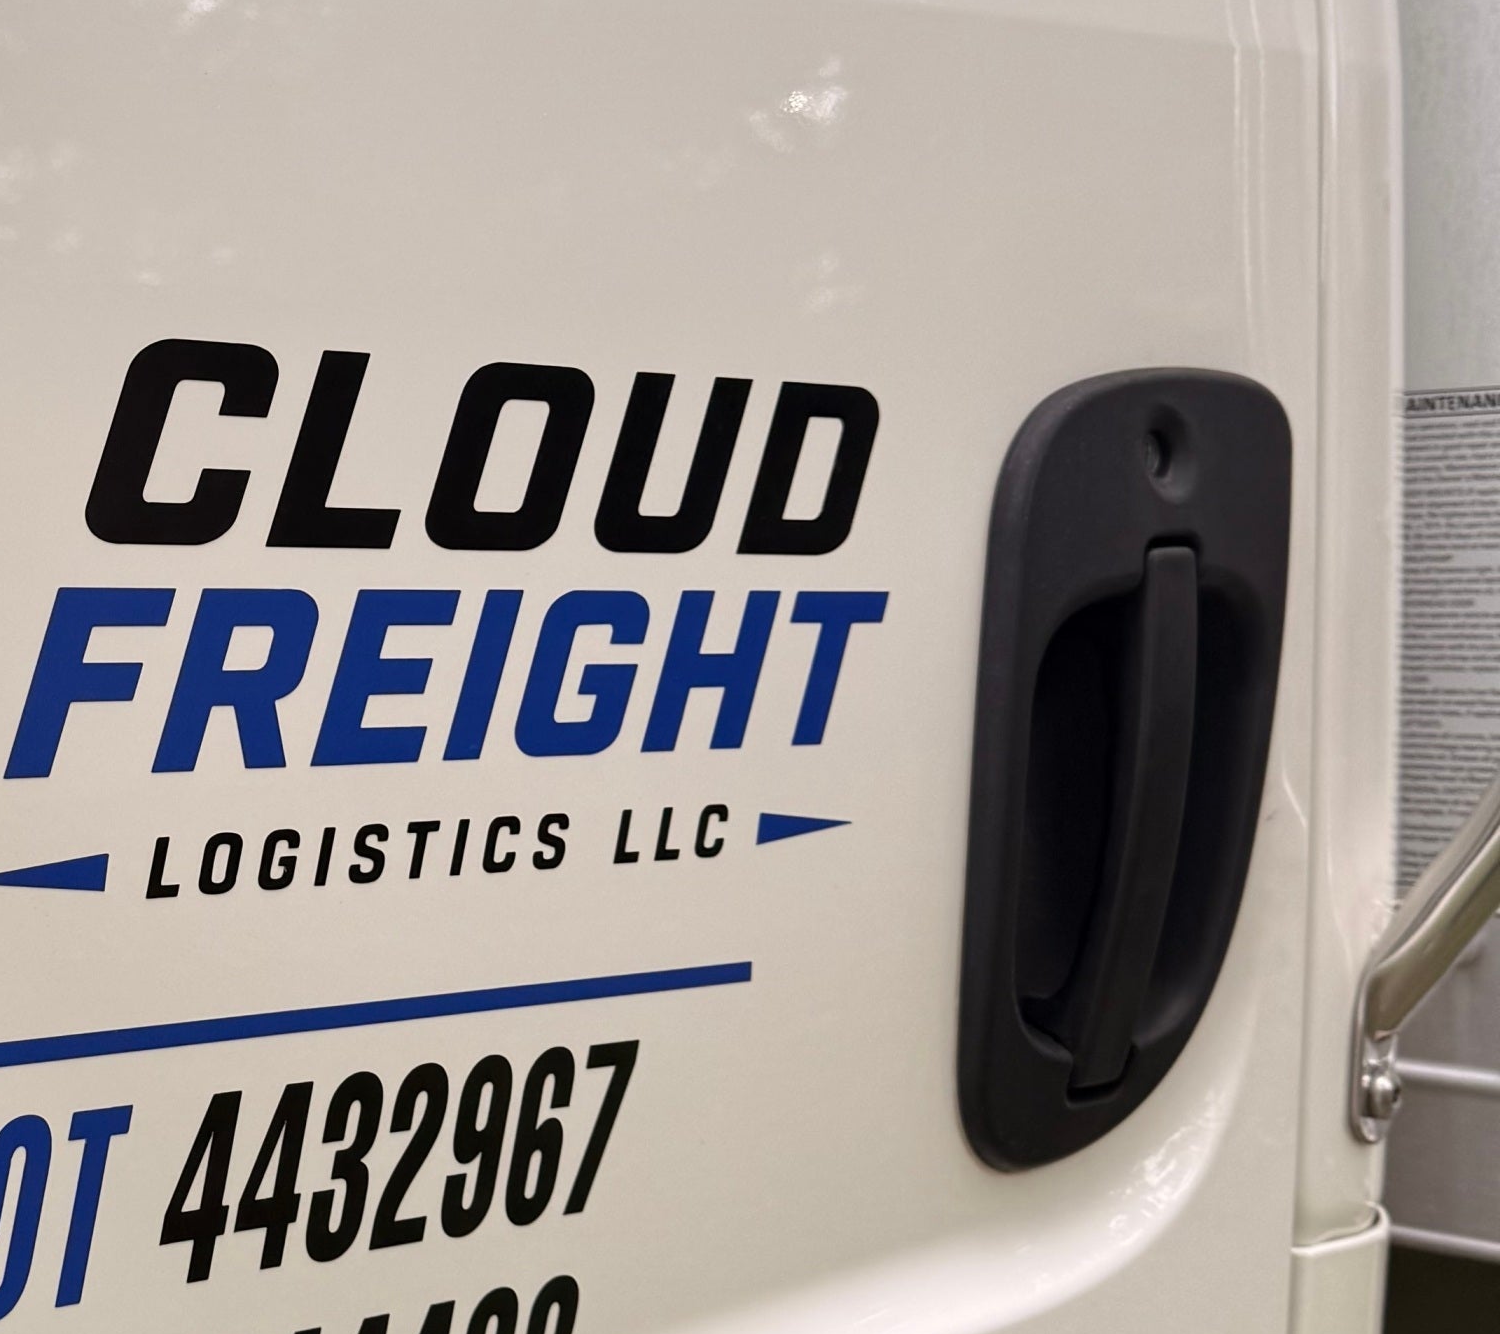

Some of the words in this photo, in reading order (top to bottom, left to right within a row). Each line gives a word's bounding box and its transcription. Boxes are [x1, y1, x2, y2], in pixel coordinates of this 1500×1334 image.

[85, 338, 879, 555] CLOUD
[3, 587, 889, 779] FREIGHT
[146, 813, 569, 899] LOGISTICS
[614, 804, 729, 865] LLC
[159, 1039, 640, 1284] 4432967
